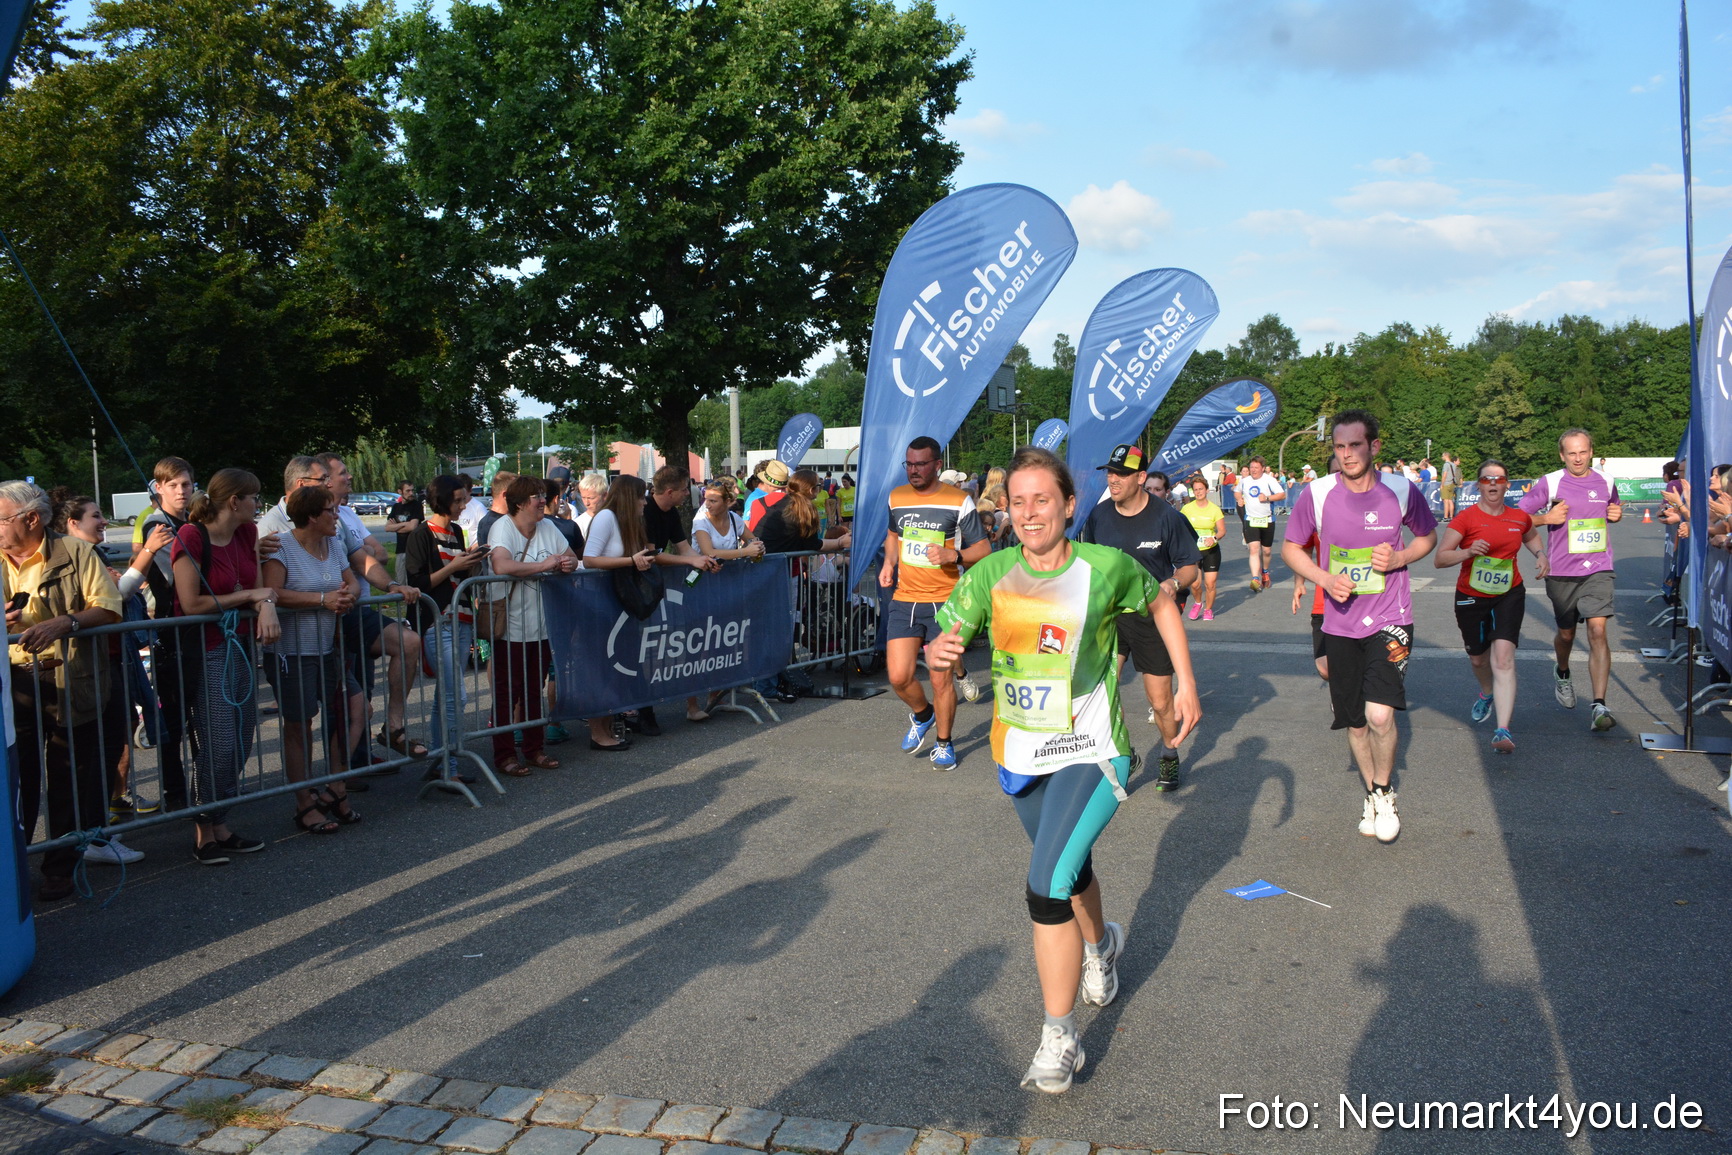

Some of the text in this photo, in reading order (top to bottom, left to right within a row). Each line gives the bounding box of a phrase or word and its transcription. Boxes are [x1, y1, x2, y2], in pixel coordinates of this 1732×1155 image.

[920, 220, 1034, 372] Fischer
[959, 249, 1045, 371] AUTOMOBILE
[1107, 292, 1187, 402] Fischer
[1137, 312, 1196, 400] AUTOMOBILE
[786, 420, 813, 457] Fischer
[1044, 425, 1061, 449] scher
[1162, 414, 1245, 465] Frischmann
[1215, 430, 1236, 444] Druck
[1248, 409, 1273, 427] Medien
[904, 520, 942, 529] Fischer
[1577, 531, 1601, 544] 459
[1339, 566, 1373, 582] 467
[1476, 569, 1509, 585] 1054
[639, 616, 751, 664] Fischer
[650, 651, 743, 684] AUTOMOBILE
[1004, 682, 1052, 711] 987
